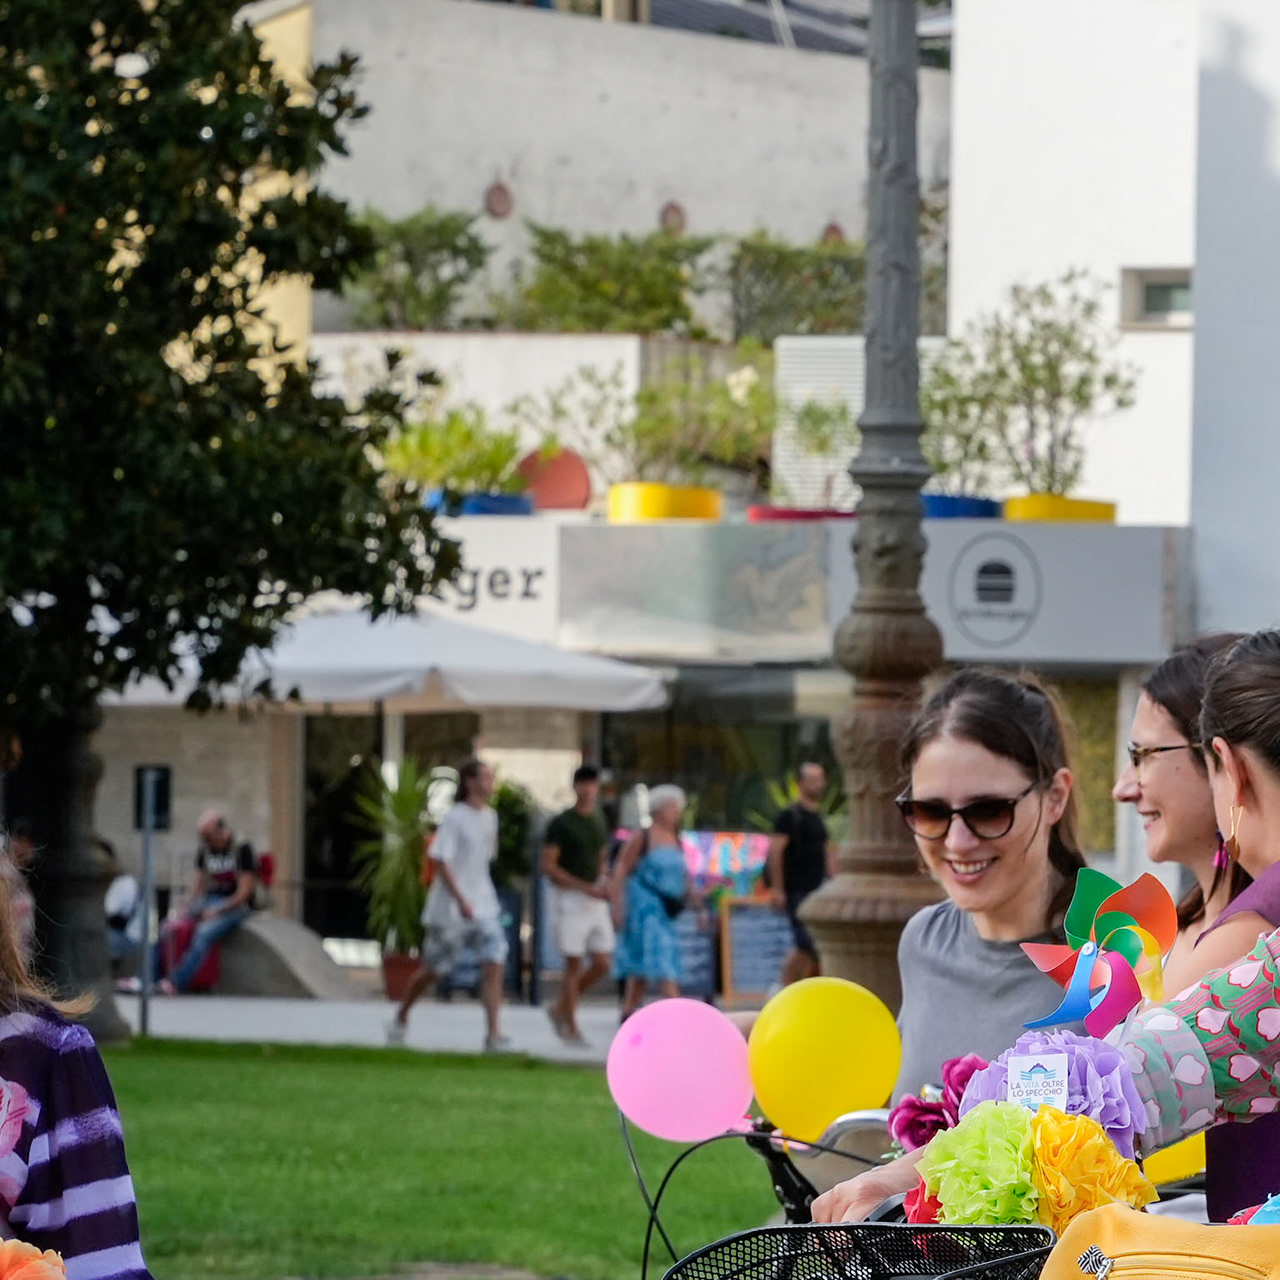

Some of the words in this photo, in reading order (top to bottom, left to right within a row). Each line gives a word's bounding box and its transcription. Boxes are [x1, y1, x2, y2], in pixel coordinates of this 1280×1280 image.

[455, 566, 544, 611] ger
[1010, 1082, 1021, 1090] LA
[1023, 1080, 1039, 1089] VITA
[1041, 1079, 1065, 1089] OLTRE
[1012, 1089, 1024, 1098] LO
[1025, 1087, 1063, 1097] SPECCHIO
